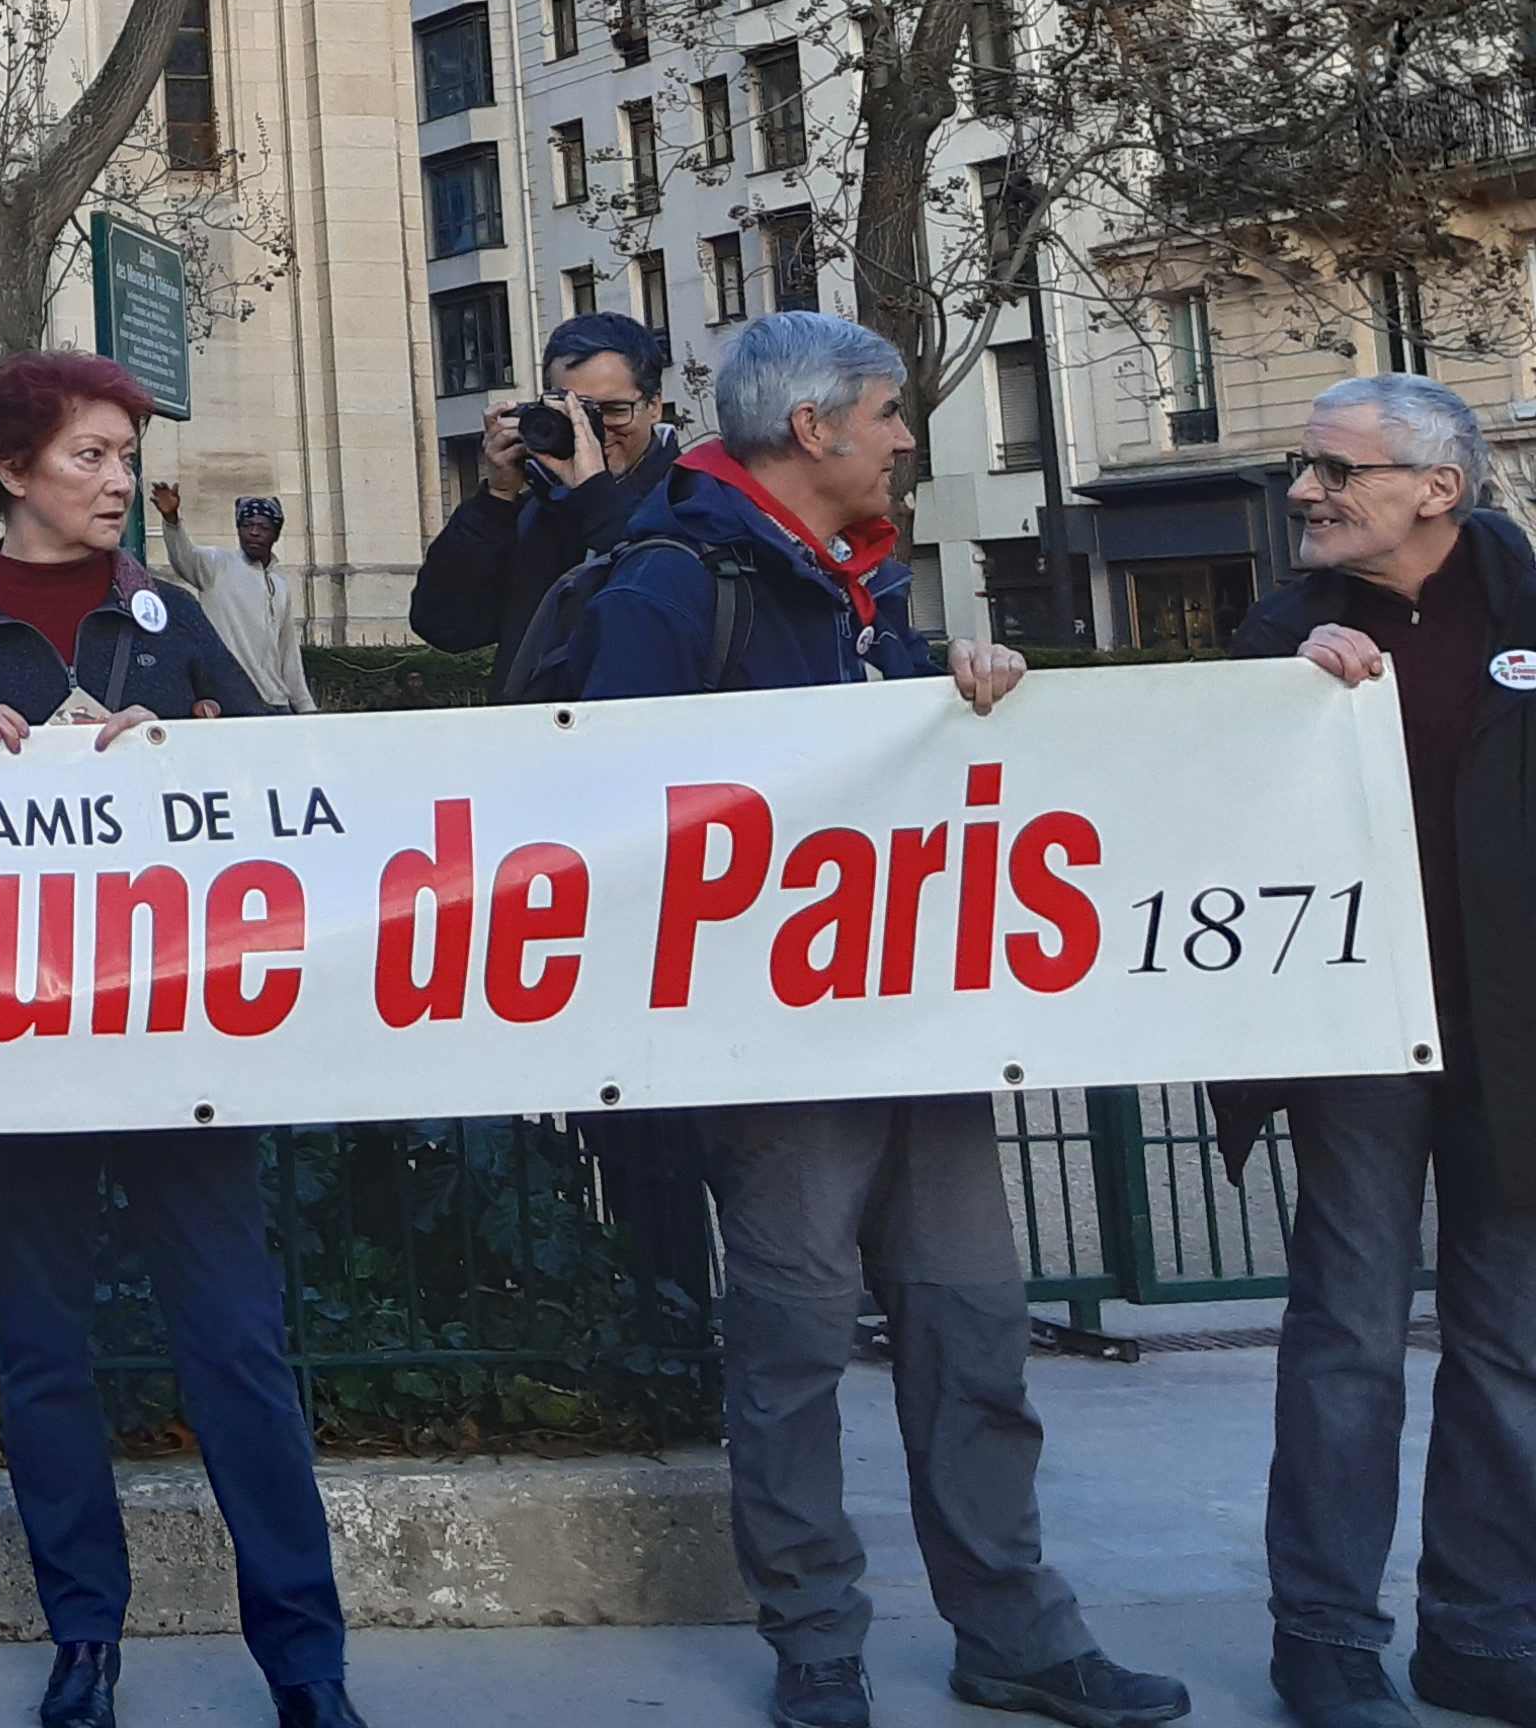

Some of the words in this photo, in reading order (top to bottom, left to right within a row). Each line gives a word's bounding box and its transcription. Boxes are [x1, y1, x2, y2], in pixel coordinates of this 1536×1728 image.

[161, 791, 236, 843] DE
[267, 786, 346, 838] LA
[375, 799, 590, 1030] de
[650, 762, 1102, 1010] Paris
[1128, 880, 1368, 975] 1871
